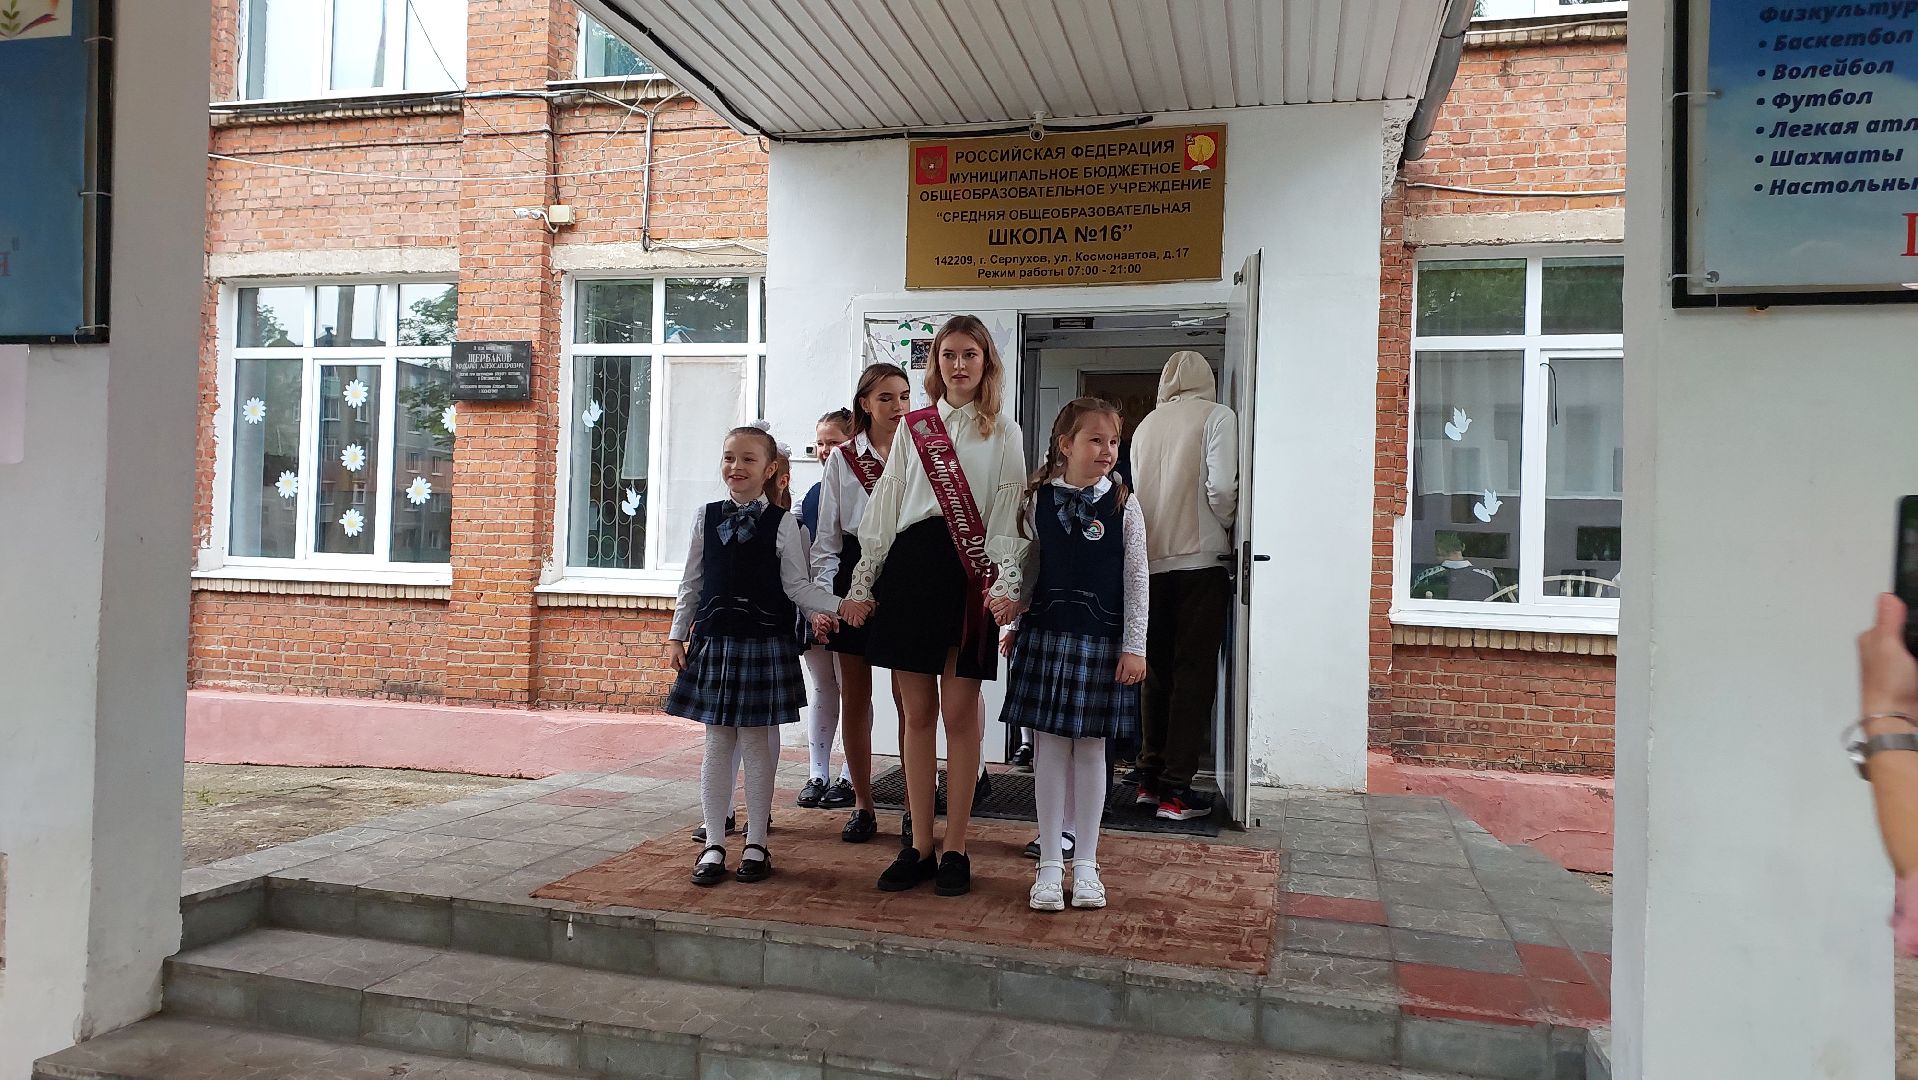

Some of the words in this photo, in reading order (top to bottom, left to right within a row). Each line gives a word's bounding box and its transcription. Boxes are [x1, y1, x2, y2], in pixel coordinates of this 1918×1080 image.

[1773, 27, 1914, 51] Баскетбол
[1772, 58, 1894, 81] Волейбол
[1771, 88, 1873, 113] Футбол
[1769, 119, 1859, 139] Легкая
[955, 145, 1066, 164] РОССИЙСКАЯ
[1071, 139, 1175, 160] ФЕДЕРАЦИЯ
[1770, 148, 1904, 167] Шахматы
[949, 167, 1079, 185] МУНИЦИПАЛЬНОЕ
[1083, 161, 1181, 180] БЮДЖЕТНОЕ
[919, 183, 1105, 202] ОБЩЕОБРАЗОВАТЕЛЬНОЕ
[1110, 177, 1212, 195] УЧРЕЖДЕНИЕ
[936, 209, 1006, 223] “СРЕДНЯЯ
[1009, 201, 1191, 222] ОБЩЕОБРАЗОВАТЕЛЬНАЯ
[988, 226, 1068, 246] ШКОЛА
[934, 255, 976, 266] 142209,
[979, 257, 986, 265] г.
[990, 254, 1051, 267] Серпухов,
[1054, 252, 1072, 265] ул.
[1075, 250, 1160, 263] Космонавтов,
[1163, 247, 1190, 261] д.17
[977, 268, 1016, 279] Режим
[1019, 266, 1064, 278] работы
[1067, 265, 1099, 277] 07:00
[1109, 263, 1142, 275] 21:00
[468, 353, 512, 363] ЩЕРБАКОВ
[925, 440, 970, 535] Выпускница
